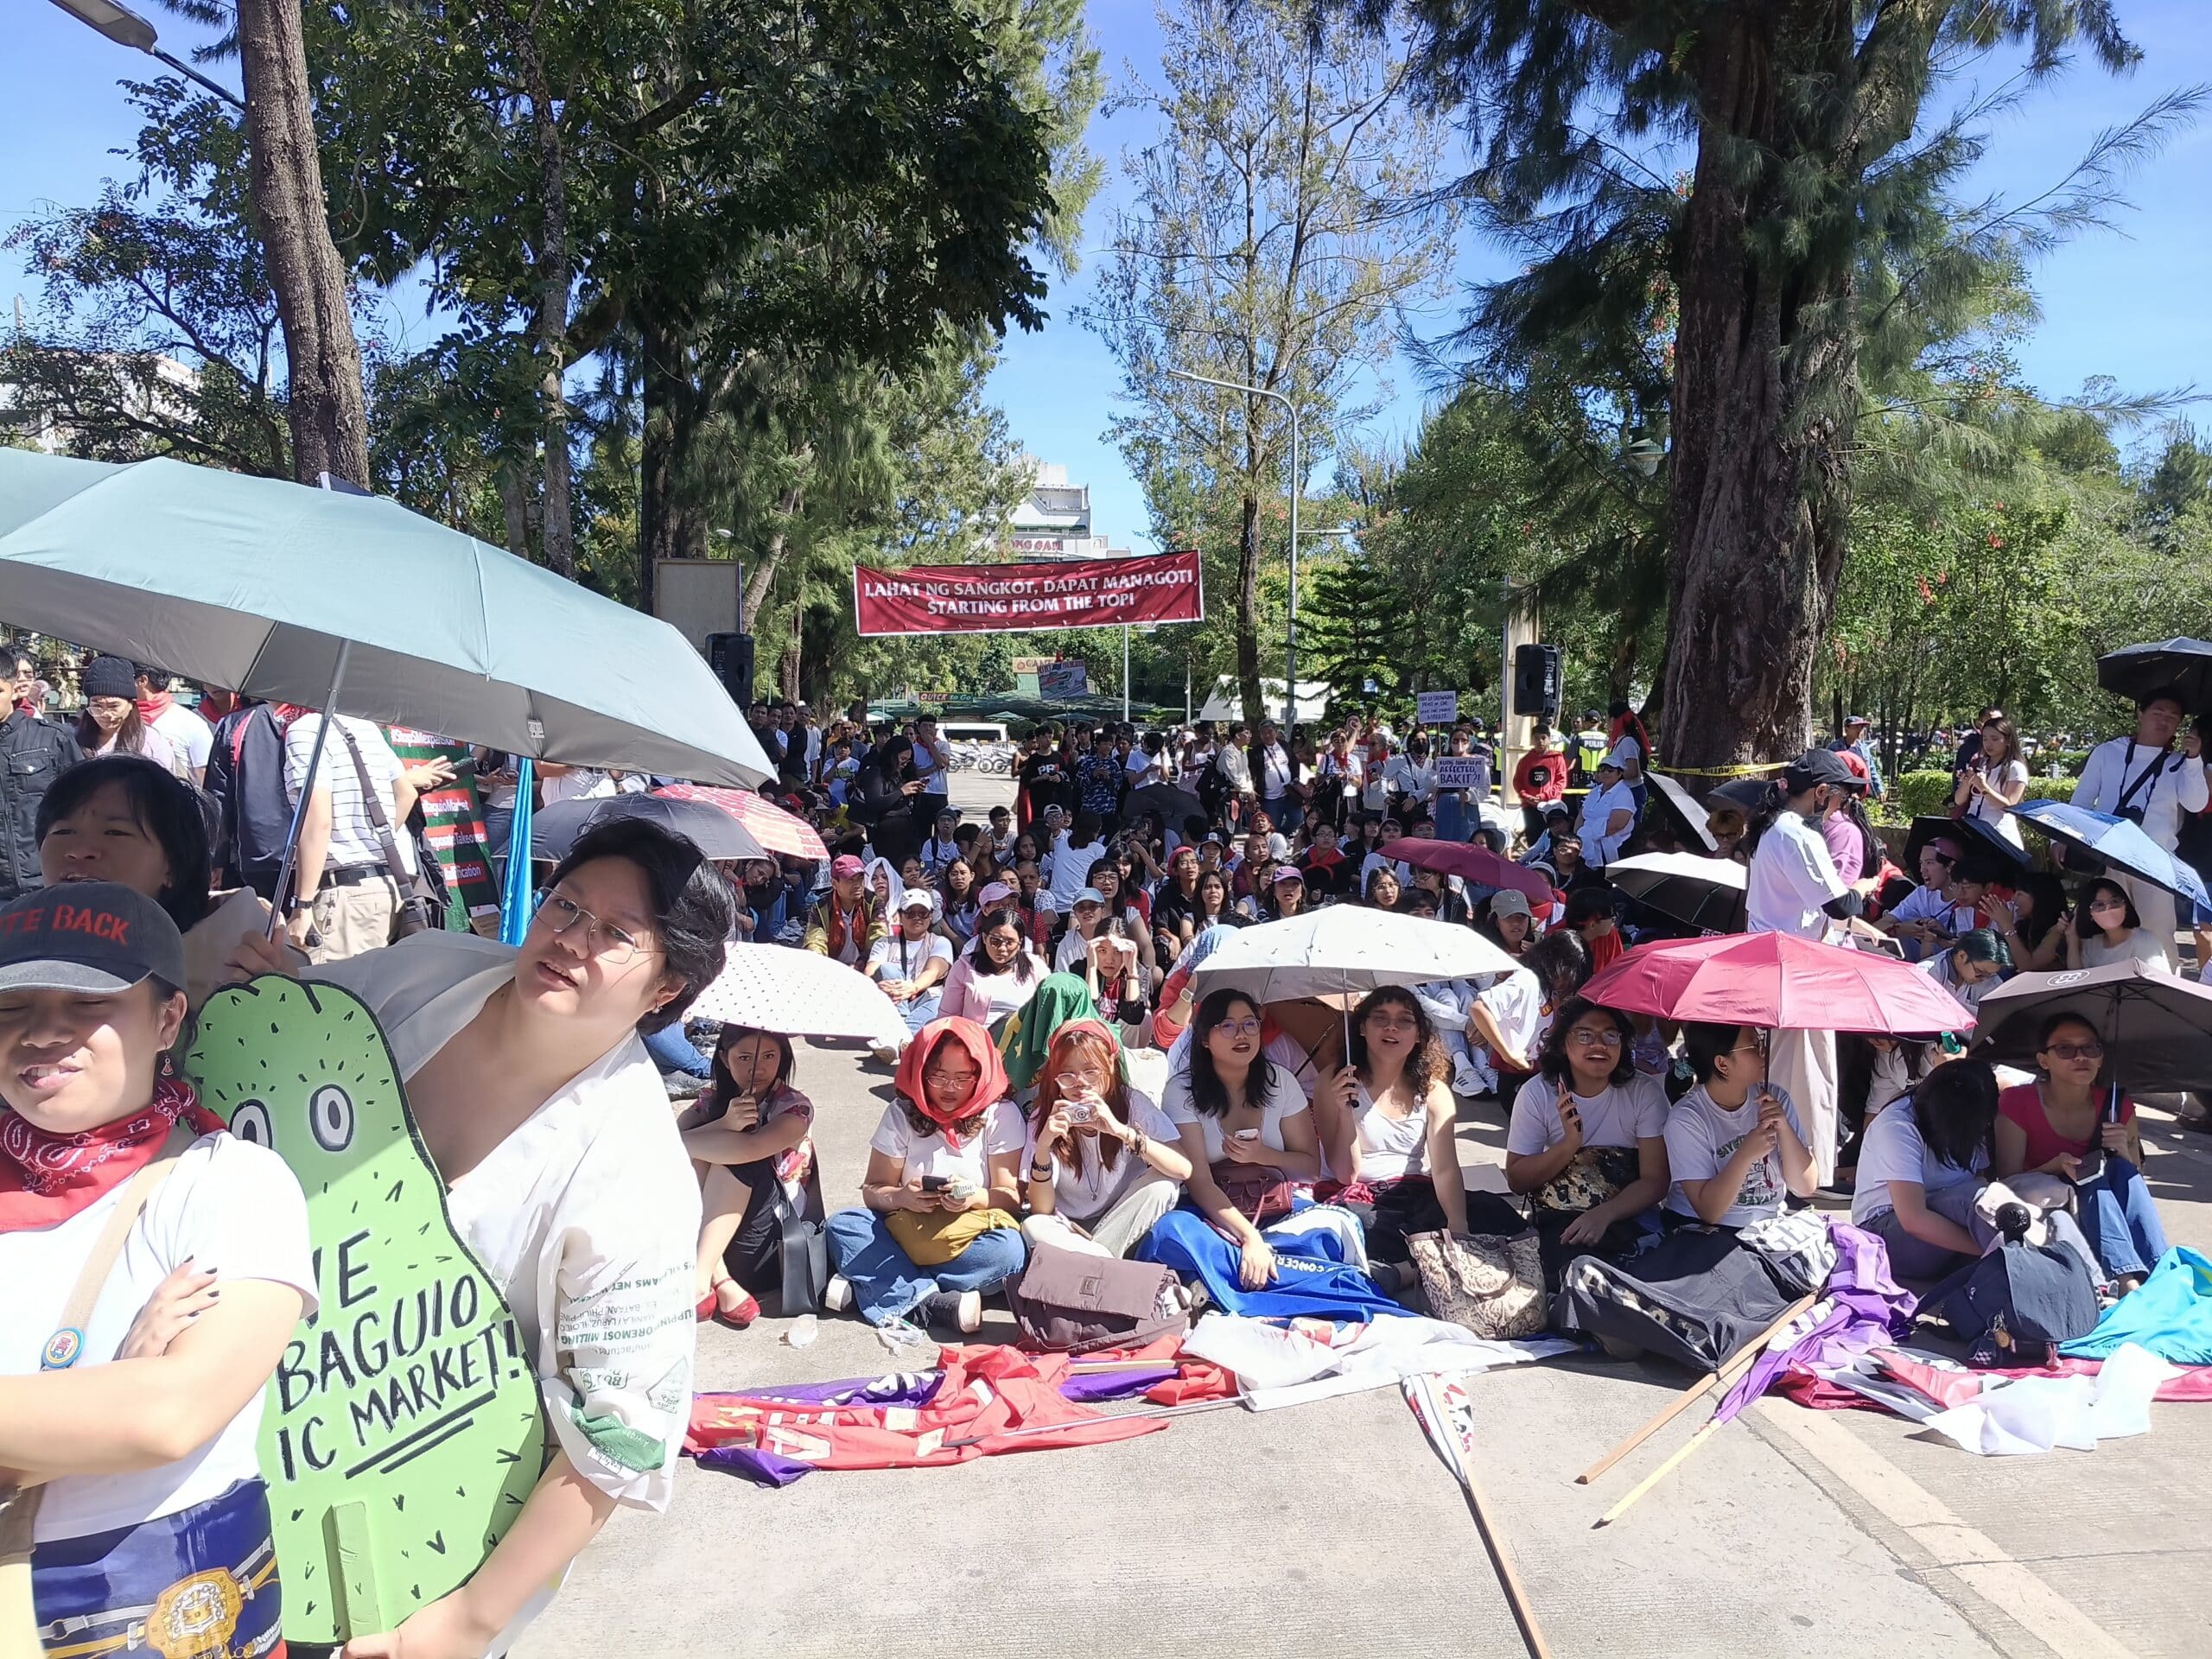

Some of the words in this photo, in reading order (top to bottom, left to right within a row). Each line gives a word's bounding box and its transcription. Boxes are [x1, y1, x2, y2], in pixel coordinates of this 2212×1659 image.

[865, 582, 920, 597] LAHAT
[925, 582, 950, 596] NG
[954, 581, 1039, 596] SANGKOT,
[1044, 576, 1098, 594] DAPAT
[1103, 569, 1193, 590] MANAGOT!
[927, 599, 1007, 615] STARTING
[1012, 596, 1060, 613] FROM
[1064, 595, 1093, 611] THE
[1096, 592, 1135, 608] TOP!
[1440, 773, 1480, 785] BAKIT?!
[0, 908, 45, 938] TE
[52, 905, 130, 946] BACK
[276, 1274, 478, 1415] BAGUIO
[602, 1326, 654, 1342] OREMOST
[349, 1319, 521, 1446] MARKET!
